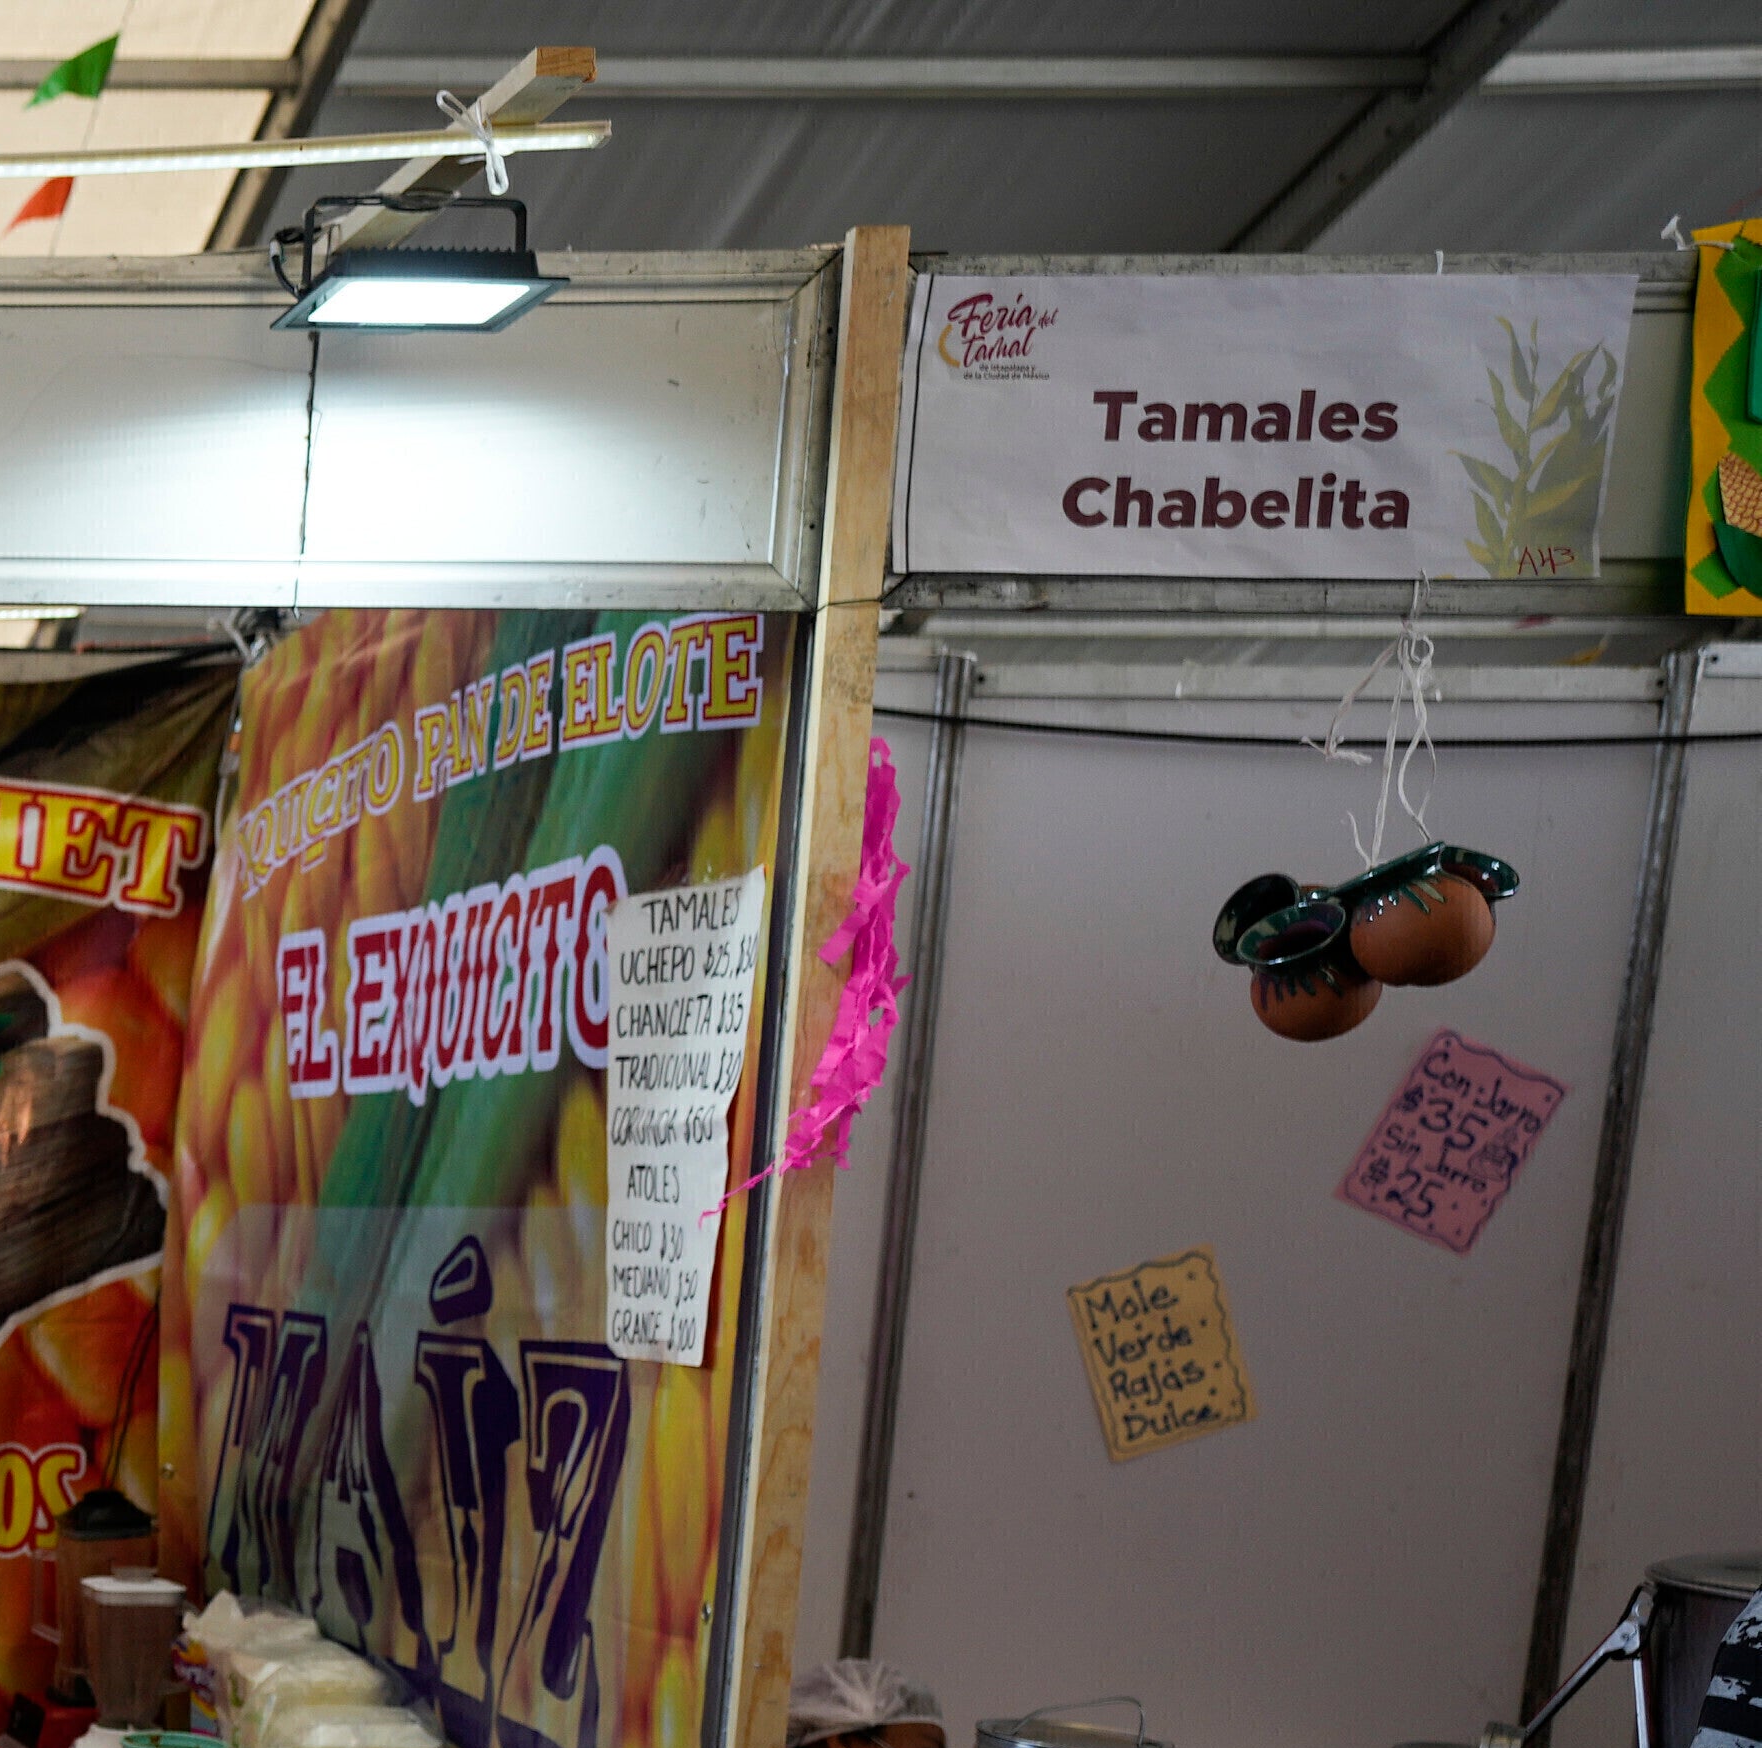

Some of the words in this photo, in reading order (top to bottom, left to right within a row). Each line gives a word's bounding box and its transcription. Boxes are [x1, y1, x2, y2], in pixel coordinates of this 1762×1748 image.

[948, 293, 1032, 337] Feria
[1094, 390, 1397, 442] Tamales
[1062, 473, 1410, 530] Chabelita
[416, 685, 491, 796] PAN
[497, 660, 550, 760] DE
[562, 615, 760, 743] ELOTE
[642, 887, 742, 934] TAMALES
[282, 946, 332, 1082] EL
[350, 867, 617, 1088] EXQUICITO
[620, 946, 695, 985] UCHEPO
[616, 995, 712, 1039] CHANCLETA
[717, 992, 744, 1034] $35
[615, 1052, 709, 1092] TRADICIONAL
[714, 1047, 742, 1095] $30
[1423, 1052, 1473, 1098] Con
[684, 1104, 713, 1145] $60
[1385, 1124, 1421, 1160] Sin
[627, 1165, 680, 1204] ATOLES
[612, 1220, 652, 1253] CHICO
[660, 1222, 684, 1263] $30
[613, 1265, 670, 1300] MEDIANO
[675, 1268, 698, 1308] $50
[1085, 1280, 1179, 1330] Mole
[1094, 1319, 1192, 1367] Verde
[1110, 1361, 1205, 1406] Rajas
[1123, 1402, 1221, 1441] Dulce
